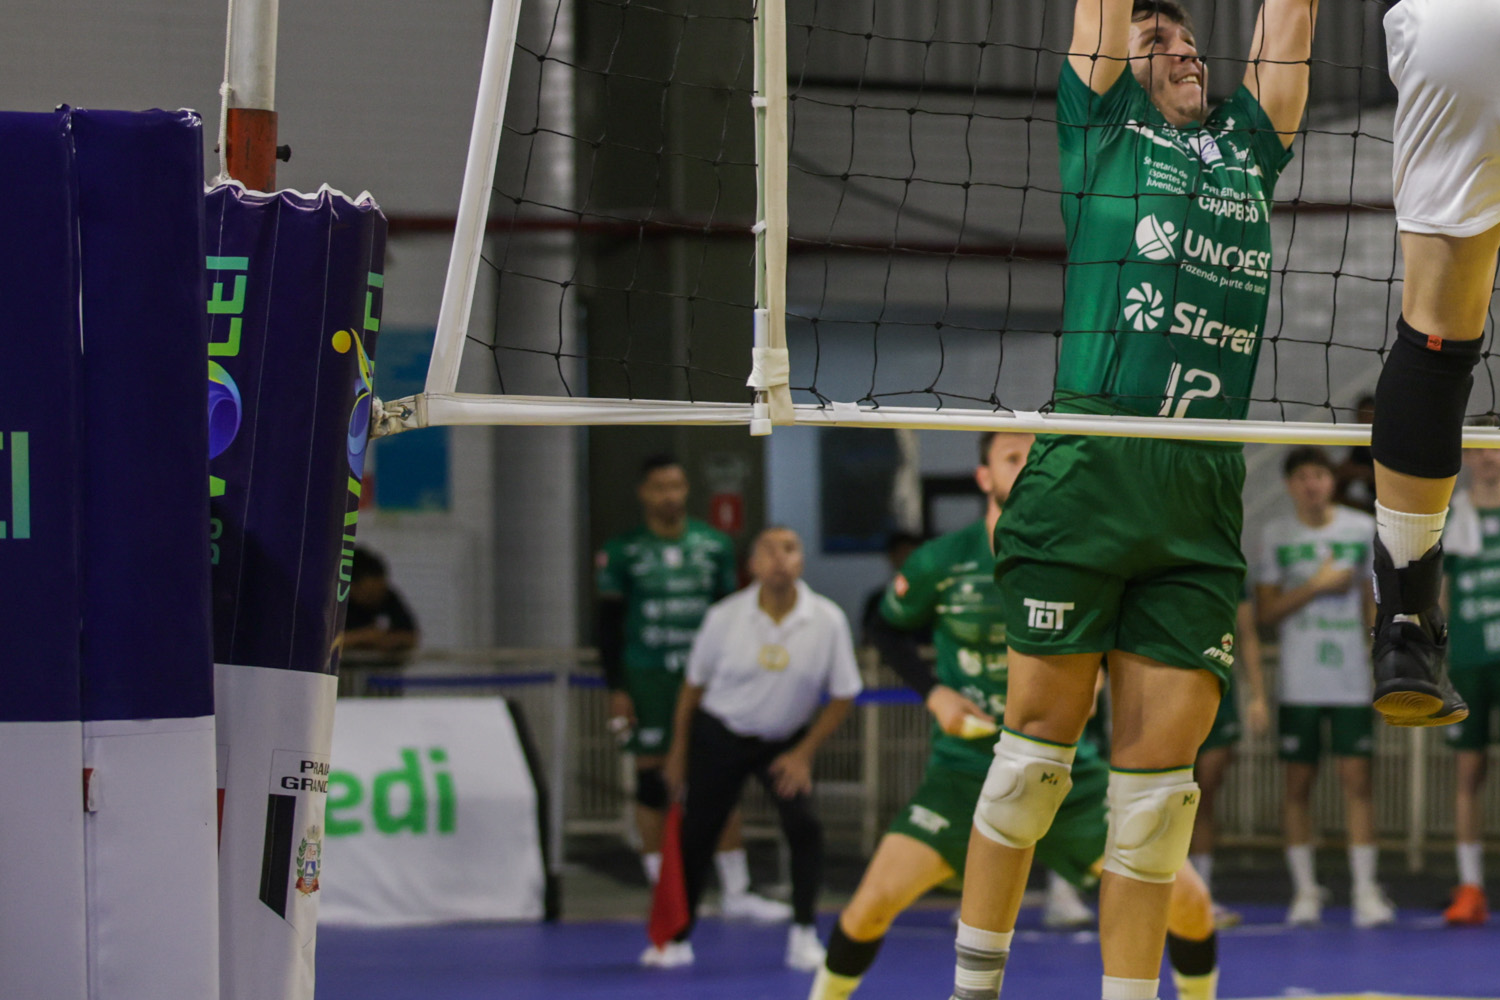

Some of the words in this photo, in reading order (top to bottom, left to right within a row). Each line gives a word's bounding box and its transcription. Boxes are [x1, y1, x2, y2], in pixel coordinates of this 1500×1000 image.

[1146, 177, 1187, 195] Juventude
[1180, 260, 1218, 283] Fazendo
[1170, 302, 1258, 356] Sicred
[1158, 361, 1221, 418] 12
[1023, 598, 1075, 630] TOT
[324, 747, 457, 836] edi
